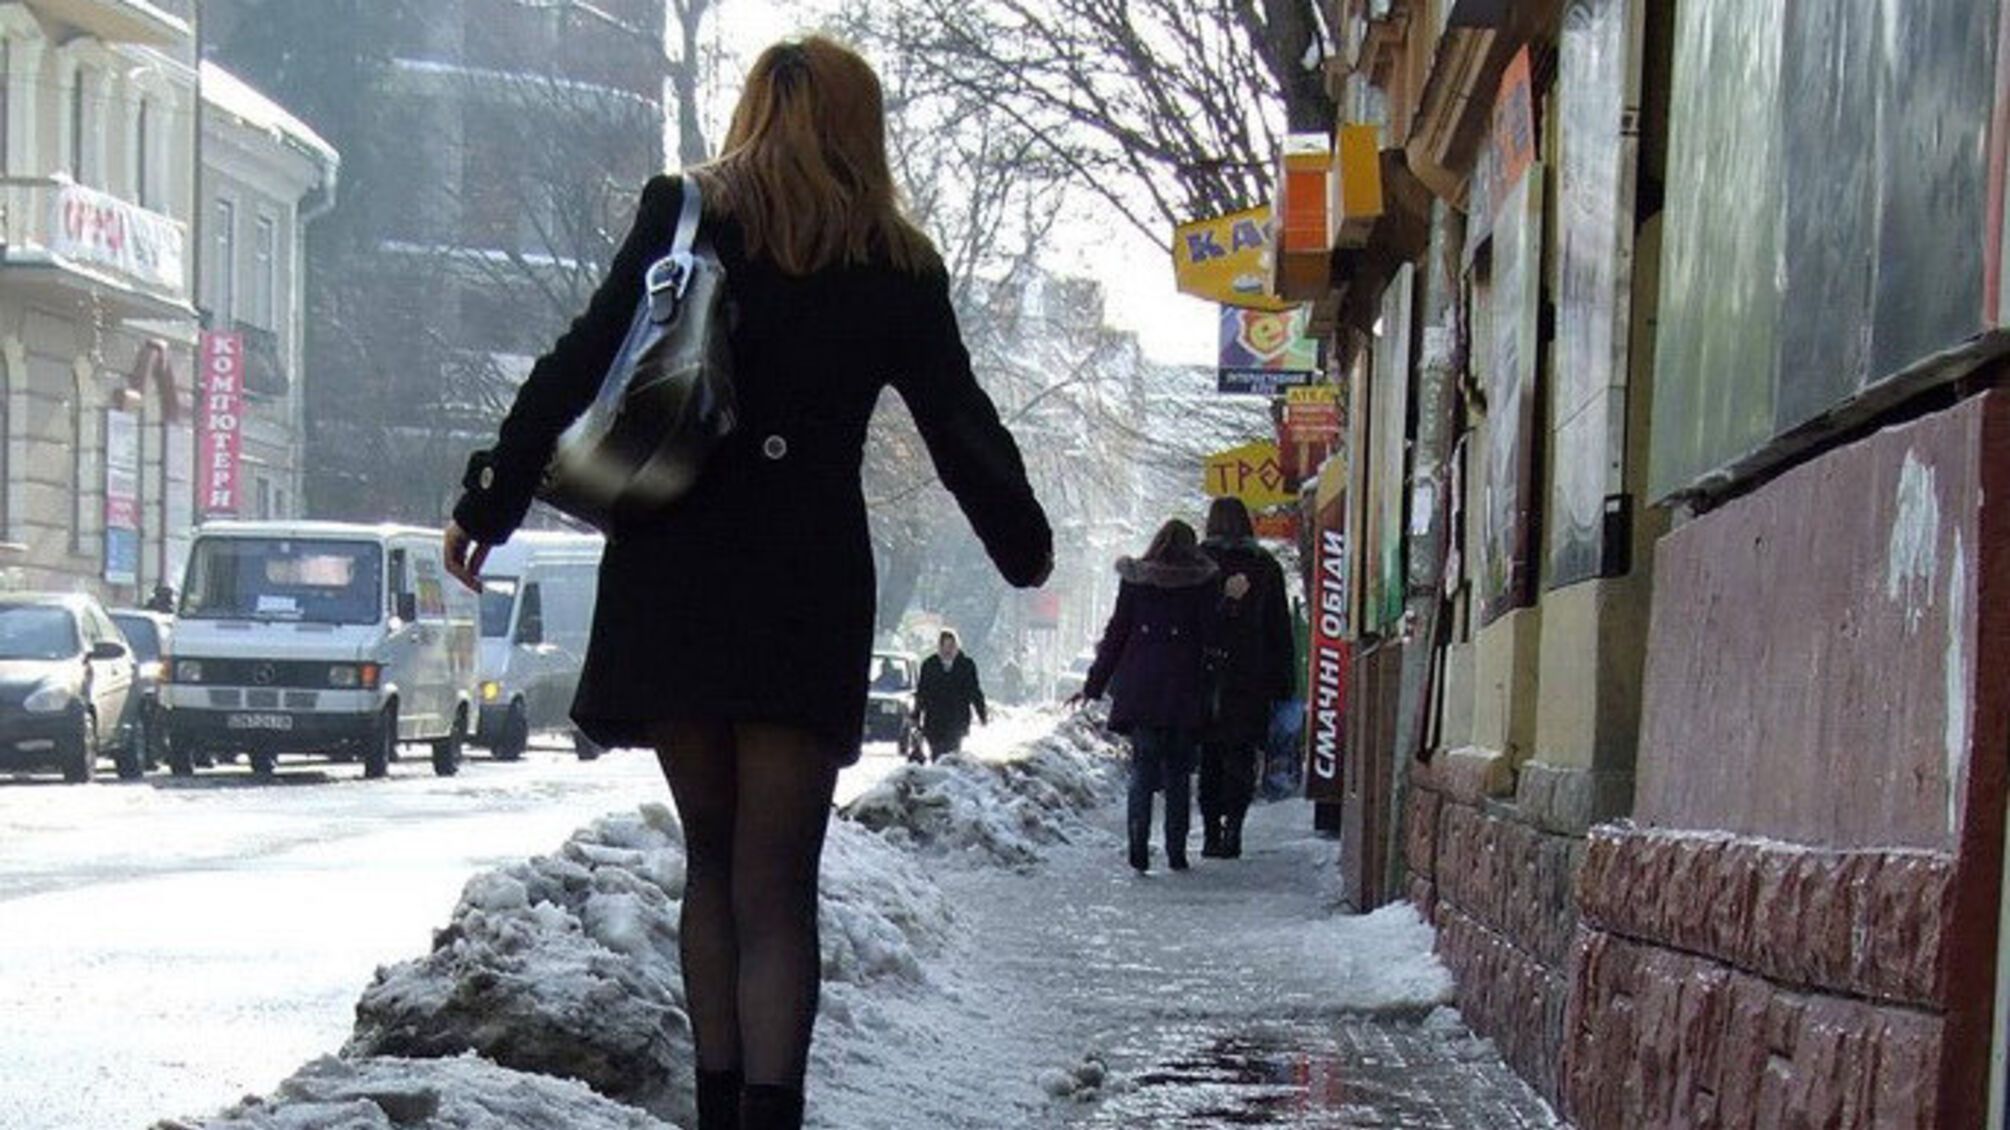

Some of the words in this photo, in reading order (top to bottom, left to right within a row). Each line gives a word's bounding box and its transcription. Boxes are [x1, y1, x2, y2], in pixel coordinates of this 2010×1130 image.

[1212, 458, 1284, 494] ТРО
[1319, 529, 1345, 642] ОБІДИ
[1314, 646, 1340, 779] СМАЧНІ
